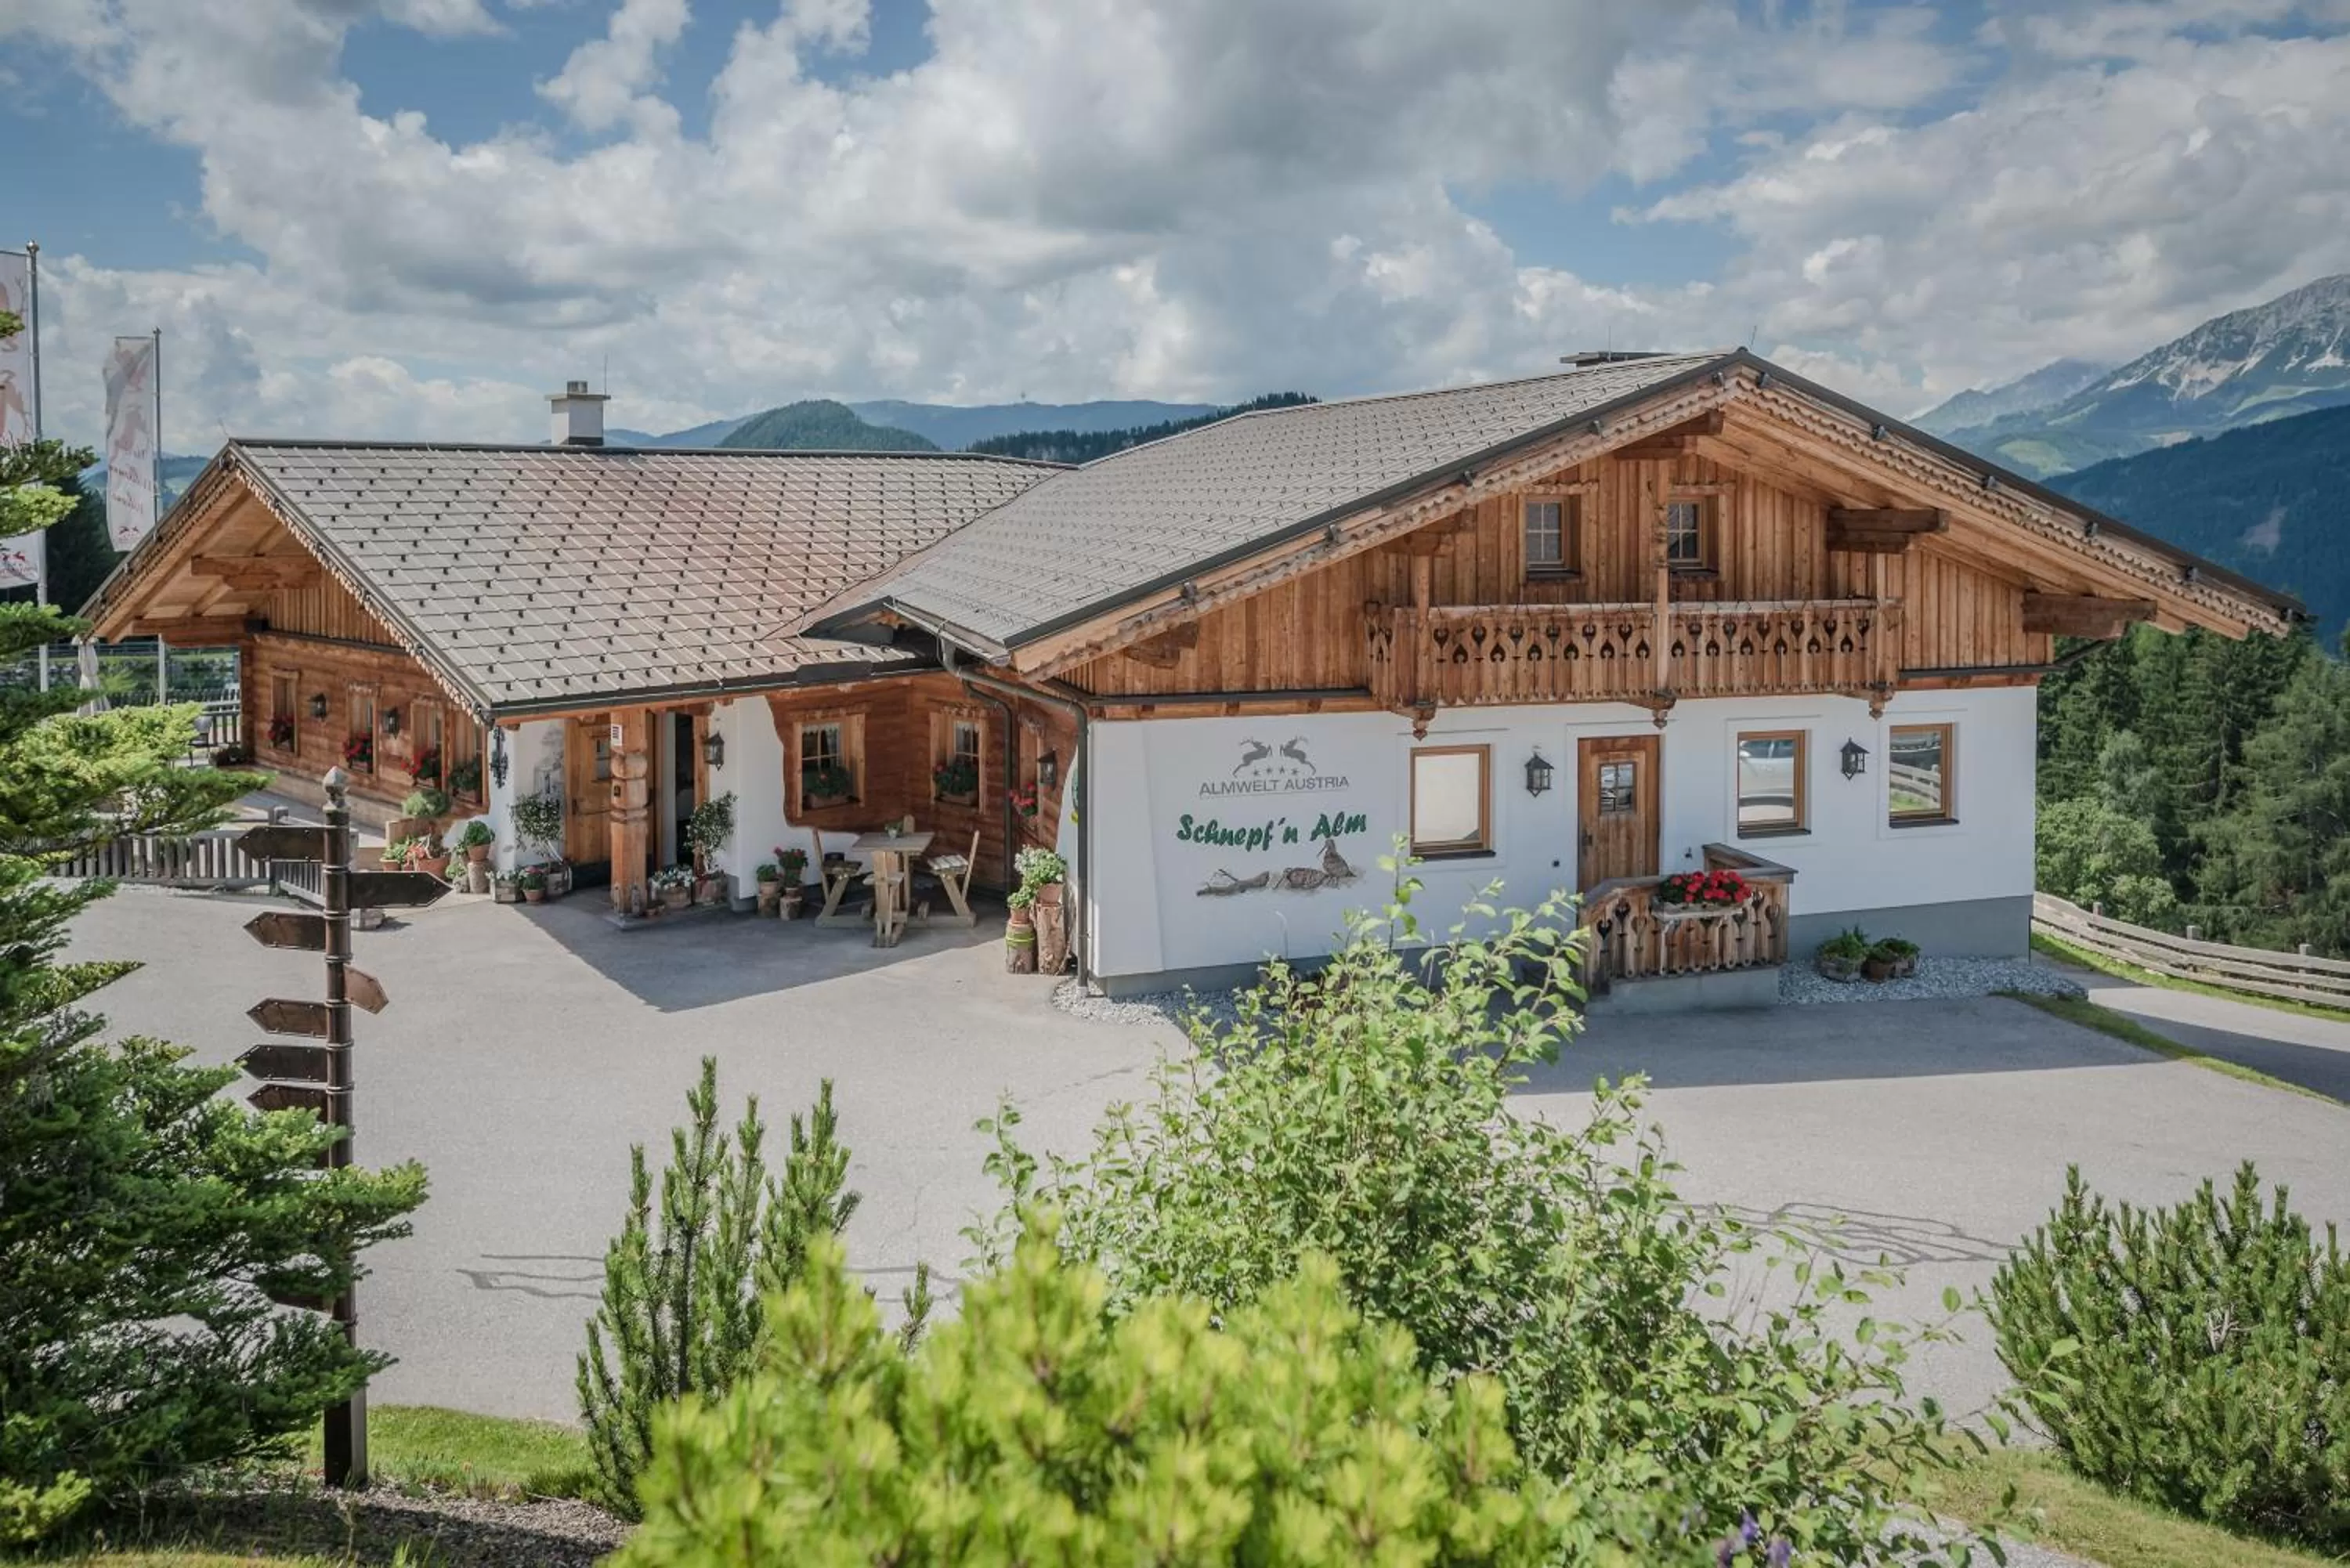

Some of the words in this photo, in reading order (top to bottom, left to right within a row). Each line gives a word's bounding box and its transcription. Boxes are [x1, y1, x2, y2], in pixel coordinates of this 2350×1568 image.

[1199, 779, 1279, 795] ALMWELT
[1284, 776, 1350, 790] AUSTRIA
[1309, 811, 1367, 841] Alm
